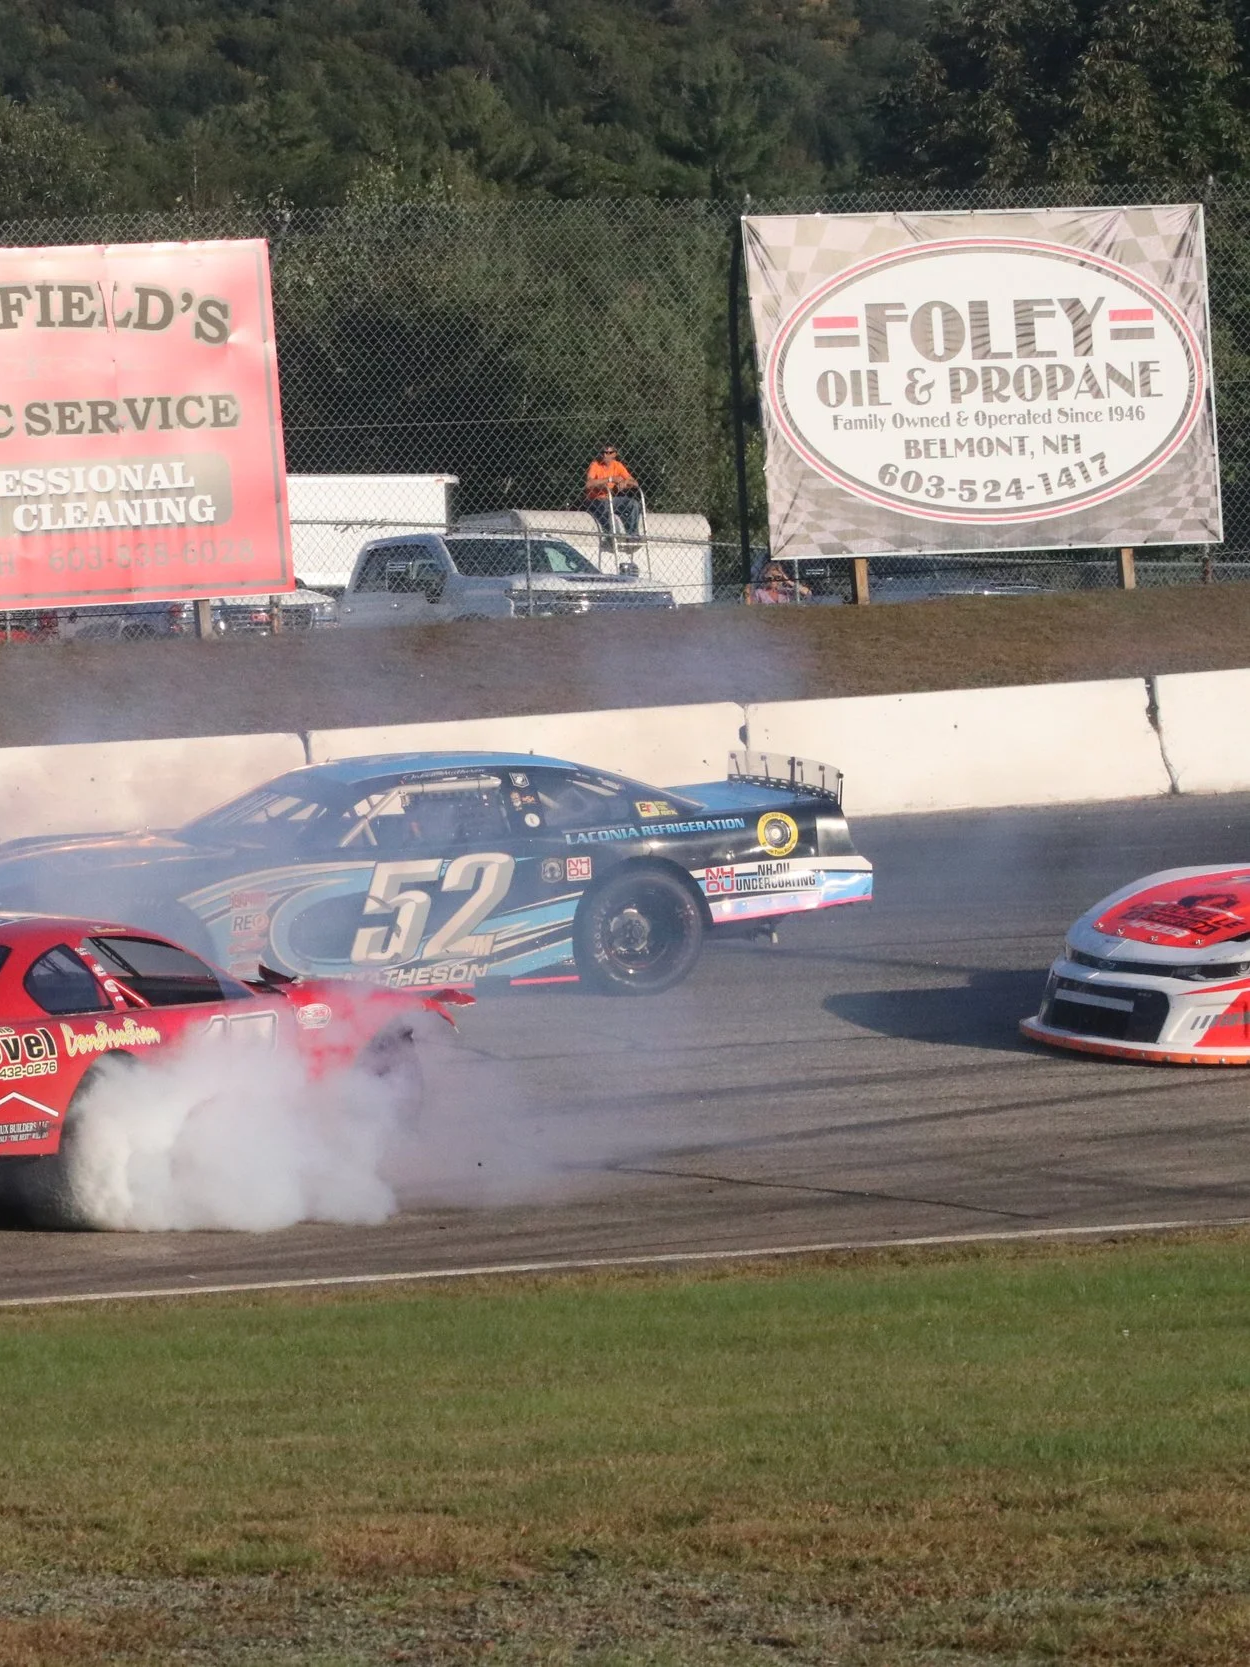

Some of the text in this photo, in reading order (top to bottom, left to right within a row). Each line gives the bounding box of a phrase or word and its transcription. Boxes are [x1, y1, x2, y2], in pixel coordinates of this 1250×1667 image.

[864, 297, 1106, 363] FOLEY
[816, 360, 1164, 408] OIL & PROPANE
[25, 394, 239, 440] SERVICE
[832, 405, 1146, 432] Family Owned & Operated Since 1946
[904, 433, 1081, 460] BELMONT, NH
[877, 451, 1110, 503] 603-524-1417
[13, 494, 217, 532] CLEANING
[566, 828, 640, 845] LACONIA
[641, 817, 746, 837] REFRIGERATION
[705, 867, 735, 880] NH
[351, 852, 516, 966] 52
